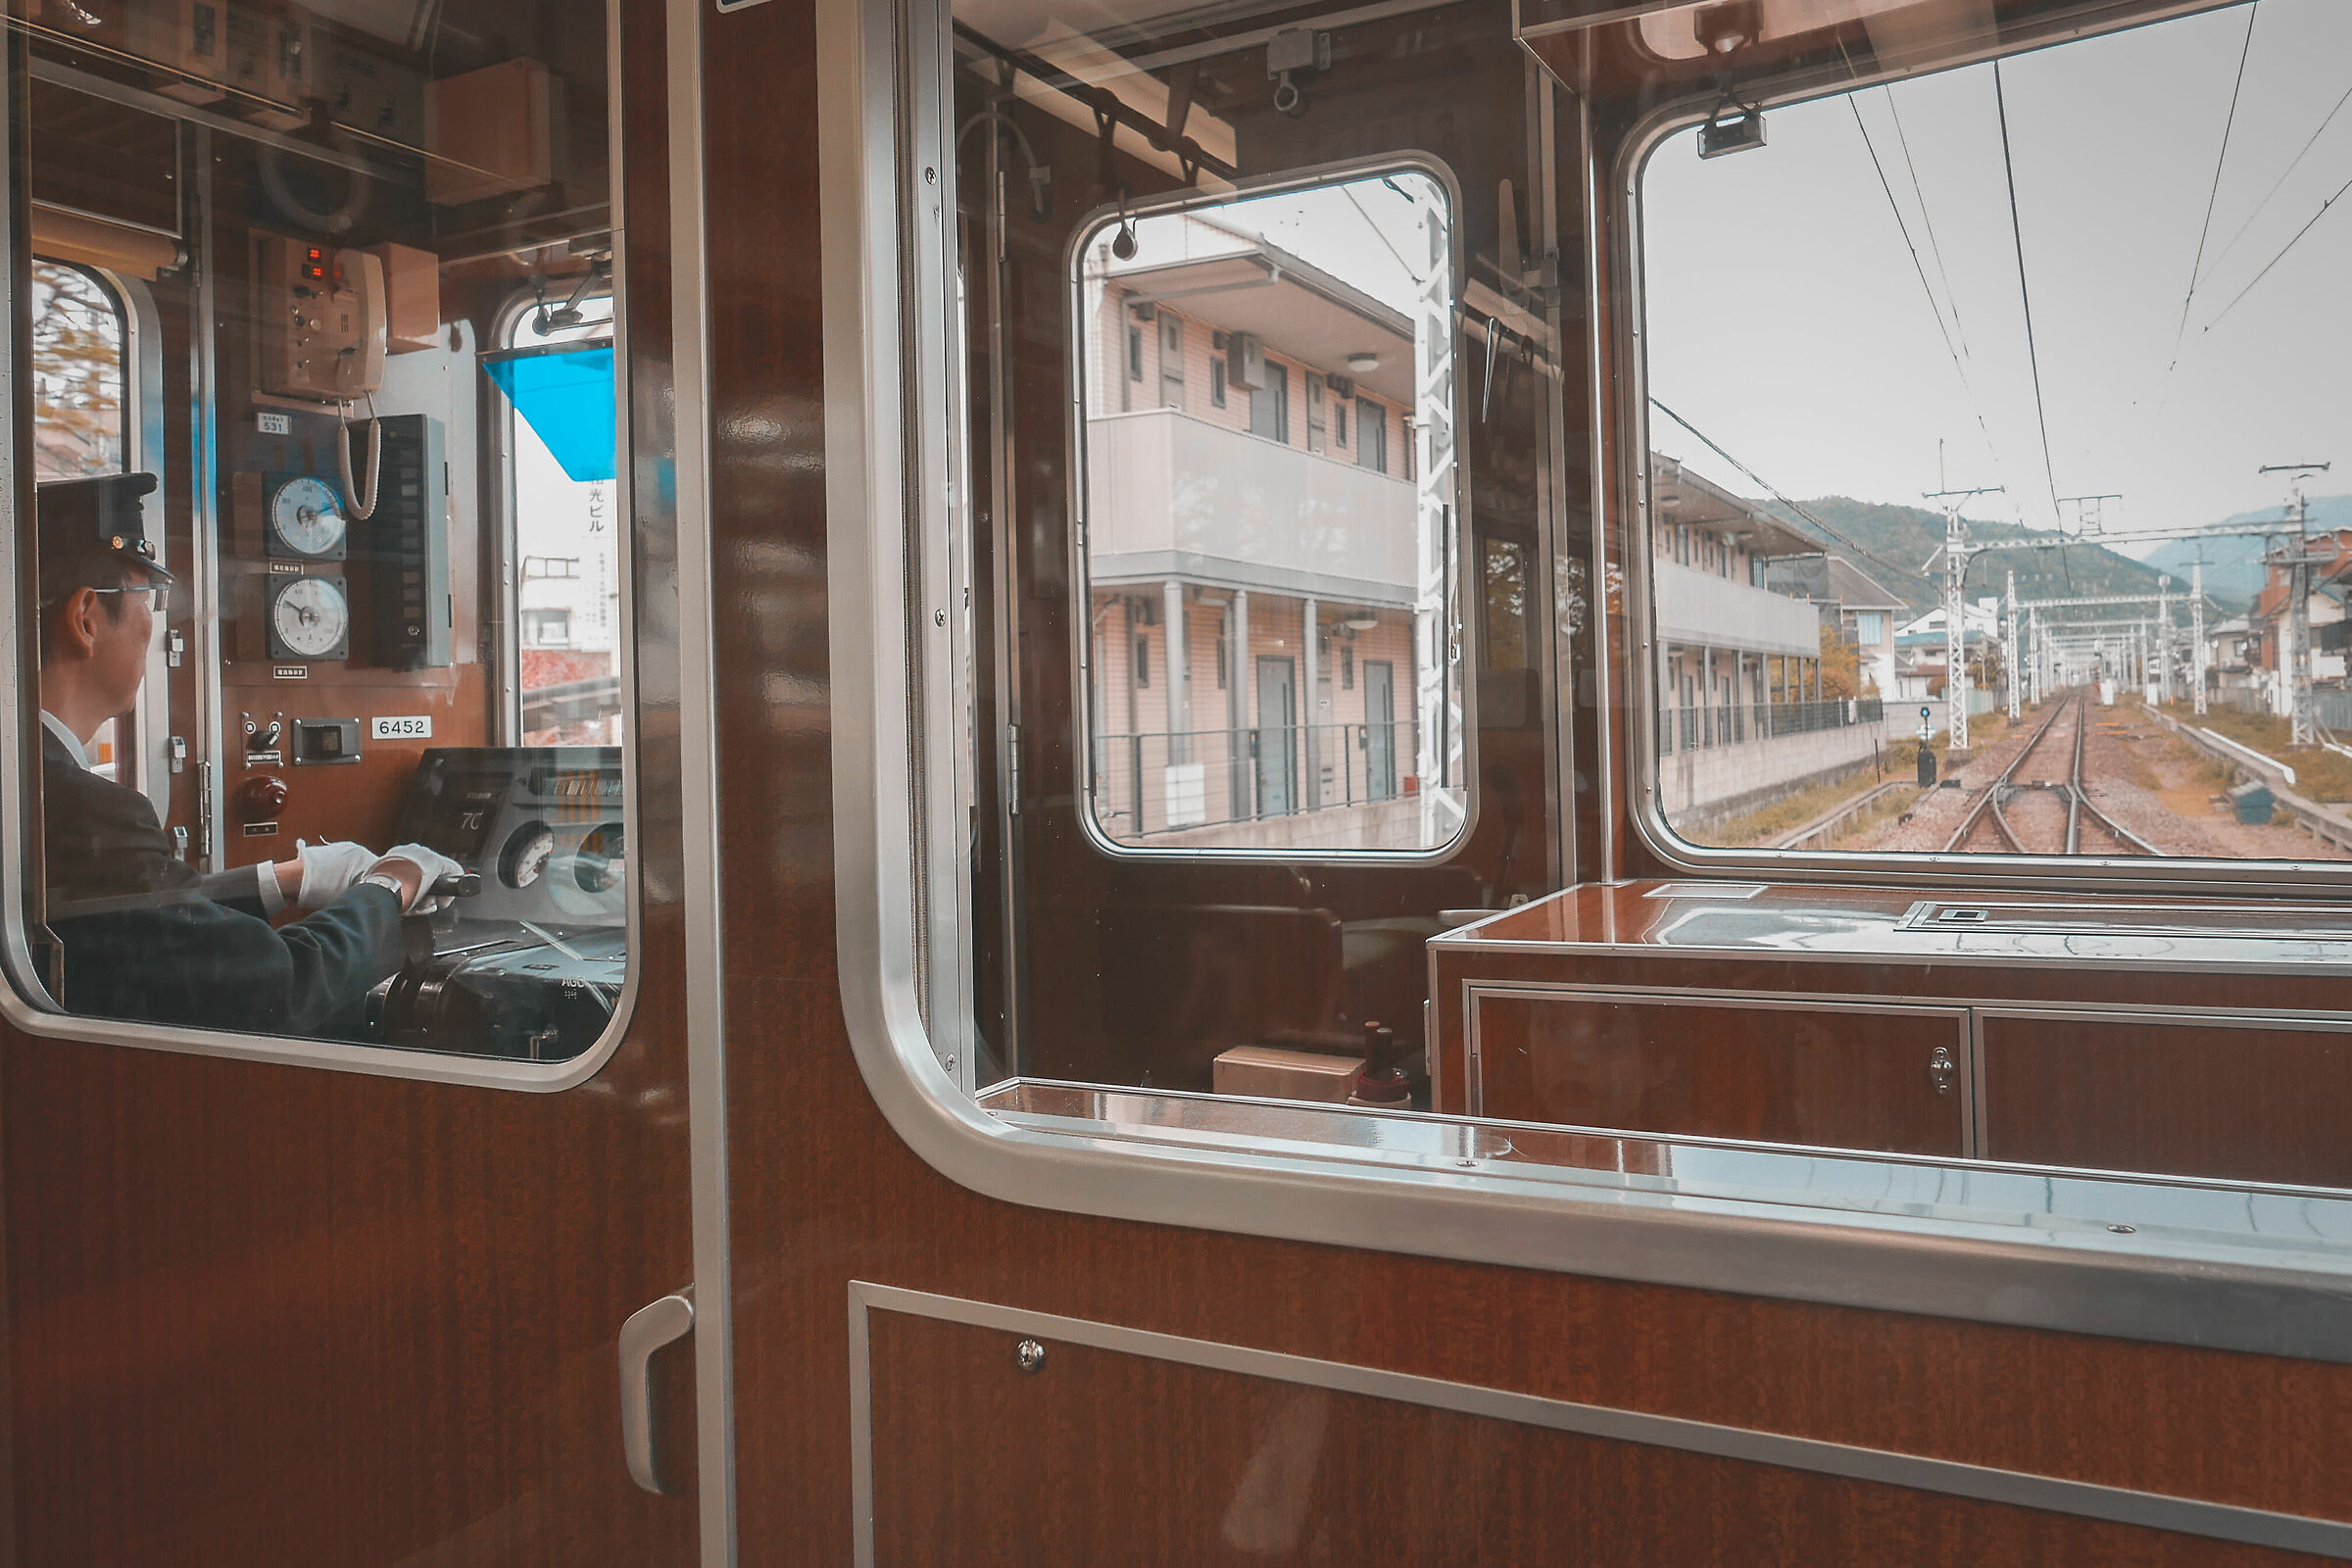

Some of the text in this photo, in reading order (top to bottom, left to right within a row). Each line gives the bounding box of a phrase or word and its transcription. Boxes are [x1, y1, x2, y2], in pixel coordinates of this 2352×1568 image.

[265, 422, 282, 432] 531
[589, 477, 605, 532] 光ビル
[379, 720, 424, 734] 6452
